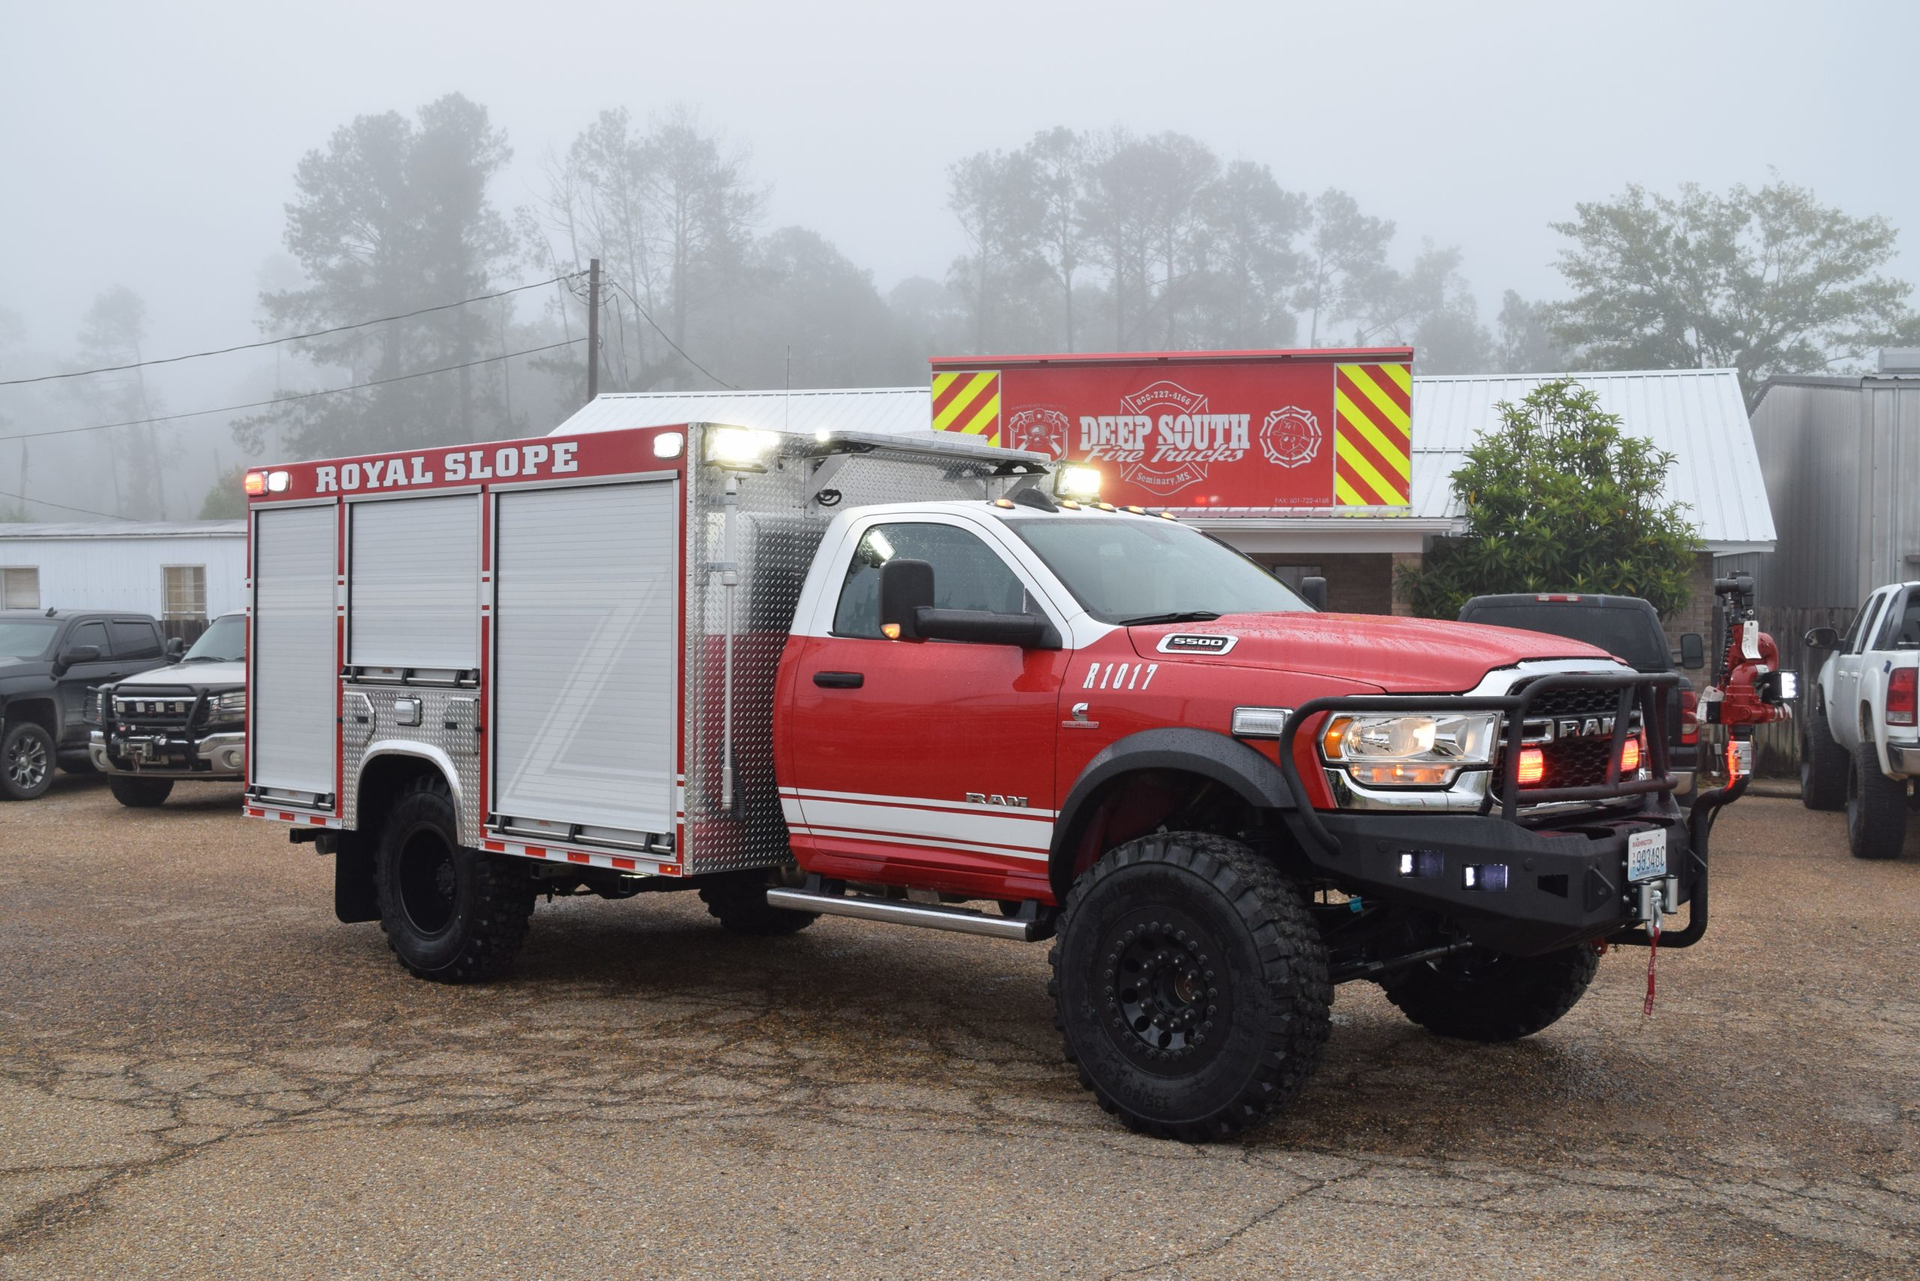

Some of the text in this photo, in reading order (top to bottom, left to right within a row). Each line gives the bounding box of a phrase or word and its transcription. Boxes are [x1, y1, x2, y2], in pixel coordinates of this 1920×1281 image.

[1079, 414, 1251, 451] DEEP SOUTH
[1084, 443, 1245, 463] Fire Trucks
[315, 441, 578, 493] ROYAL SLOPE
[1174, 637, 1223, 646] 5500
[1082, 662, 1159, 690] R1017
[966, 792, 1028, 808] RAM
